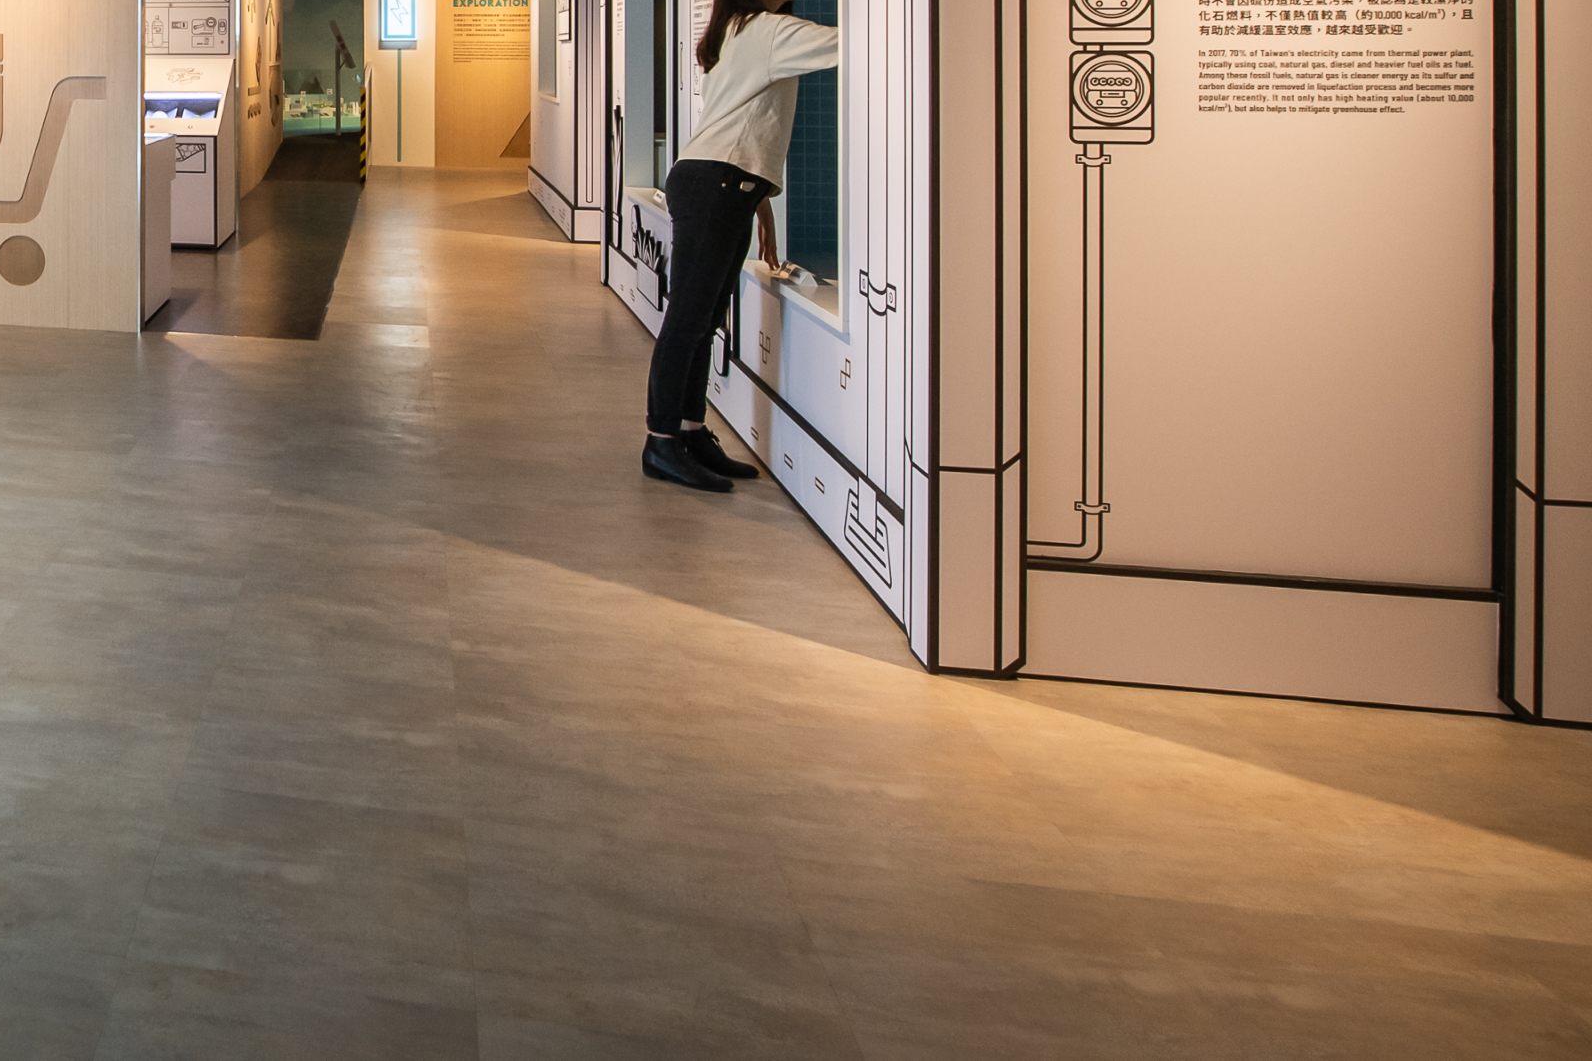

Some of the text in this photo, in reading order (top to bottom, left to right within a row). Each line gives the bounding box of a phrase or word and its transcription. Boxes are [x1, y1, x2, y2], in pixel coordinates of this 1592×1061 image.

[1198, 49, 1206, 57] In
[1229, 49, 1247, 57] 70%
[1249, 49, 1258, 57] of
[1259, 49, 1295, 57] Taiwan's
[1296, 49, 1339, 59] electricity
[1365, 49, 1386, 57] from
[1387, 49, 1420, 57] thermal
[1422, 51, 1448, 59] power
[1198, 60, 1233, 70] typically
[1234, 61, 1257, 70] using
[1279, 61, 1309, 69] natural
[1329, 61, 1355, 69] diesel
[1356, 60, 1372, 69] and
[1374, 60, 1406, 69] heavier
[1407, 60, 1424, 69] fuel
[1425, 60, 1441, 69] oils
[1198, 71, 1225, 81] Among
[1226, 71, 1248, 79] these
[1249, 71, 1271, 79] fossil
[1325, 73, 1340, 81] gas
[1341, 71, 1349, 79] is
[1381, 73, 1409, 81] energy
[1421, 71, 1433, 80] its
[1434, 72, 1458, 80] sulfur
[1459, 72, 1475, 80] and
[1198, 82, 1226, 90] carbon
[1226, 82, 1255, 90] dioxide
[1271, 83, 1306, 91] removed
[1316, 83, 1364, 92] liquefaction
[1365, 84, 1397, 92] process
[1398, 83, 1414, 91] and
[1415, 83, 1452, 91] becomes
[1198, 94, 1230, 103] popular
[1281, 94, 1295, 102] not
[1297, 94, 1315, 103] only
[1317, 94, 1333, 102] has
[1335, 94, 1354, 104] high
[1356, 94, 1389, 104] heating
[1391, 94, 1415, 102] value
[1416, 93, 1445, 103] (about
[1234, 104, 1247, 112] but
[1248, 104, 1265, 112] also
[1265, 104, 1287, 114] helps
[1288, 105, 1297, 113] to
[1298, 105, 1331, 115] mitigate
[1331, 105, 1378, 115] greenhouse
[1379, 105, 1406, 114] effect.
